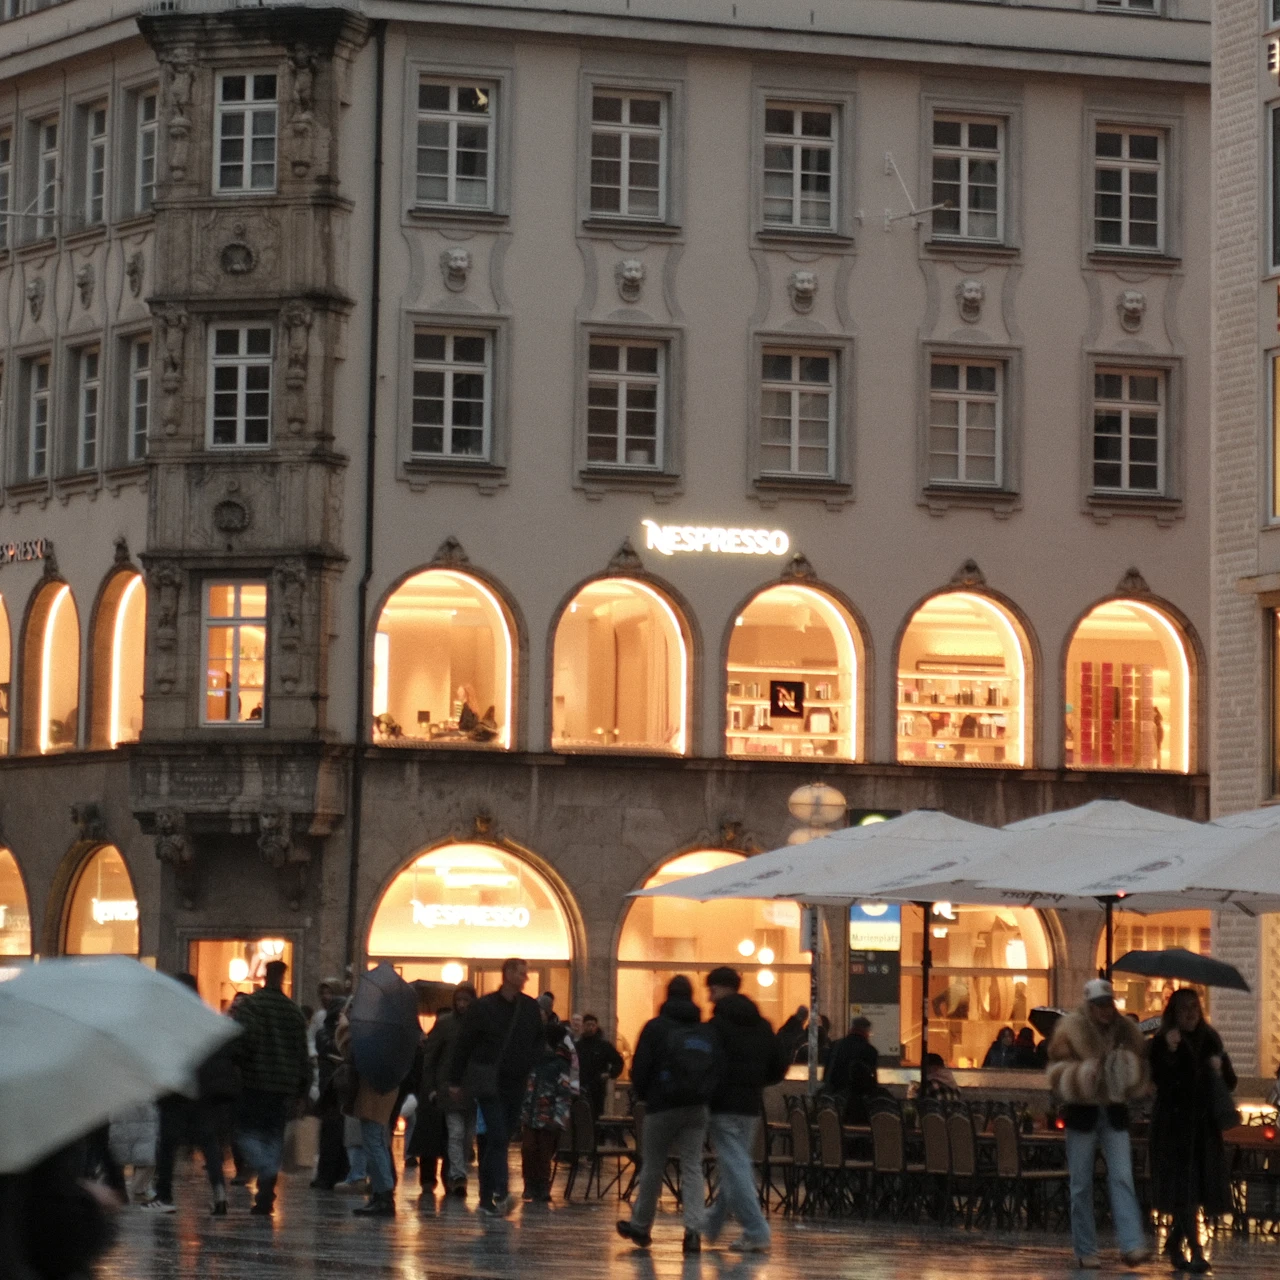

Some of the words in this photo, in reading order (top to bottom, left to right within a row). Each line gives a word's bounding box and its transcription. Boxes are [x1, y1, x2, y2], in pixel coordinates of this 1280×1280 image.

[640, 519, 790, 556] NESPRESSO
[409, 899, 531, 929] NESPRESSO
[851, 933, 899, 945] Marienplatz
